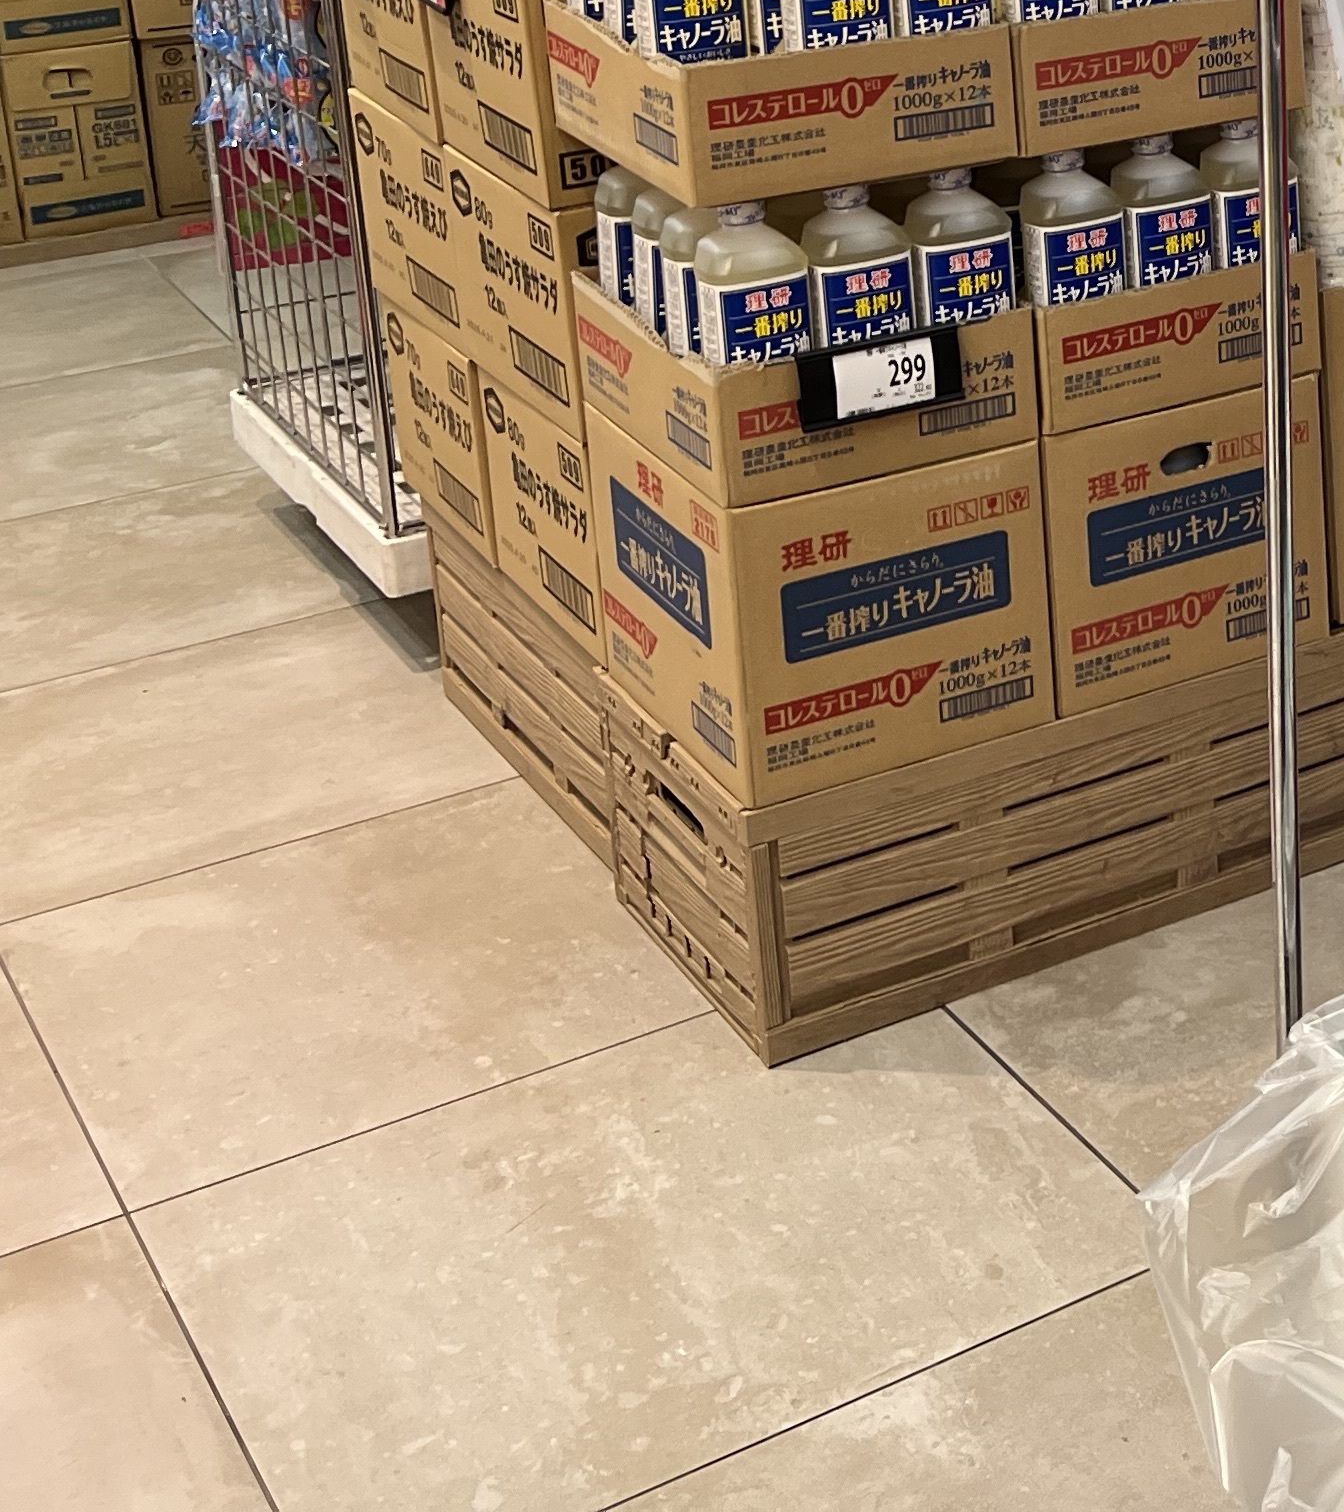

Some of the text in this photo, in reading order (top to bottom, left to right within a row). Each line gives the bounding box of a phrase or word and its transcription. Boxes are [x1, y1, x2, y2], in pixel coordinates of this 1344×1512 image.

[658, 15, 743, 54] キャノーラ油
[913, 3, 991, 35] キャノーラ油
[806, 20, 889, 52] キャノーラ油
[1038, 39, 1173, 86] コレステロール0
[712, 85, 864, 126] コレステロール0
[846, 268, 891, 293] 理研
[939, 269, 1003, 298] 一番搾り
[744, 285, 791, 312] 理研
[836, 290, 902, 320] 一番搾り
[934, 292, 1011, 325] キャノーラ油
[735, 308, 803, 339] 一番搾り
[1065, 312, 1194, 359] コレステロール0
[887, 354, 926, 387] 299
[801, 565, 994, 641] 一番搾りキャノーラ油
[1074, 593, 1201, 650] コレステロール0
[768, 672, 913, 733] コレステロール0
